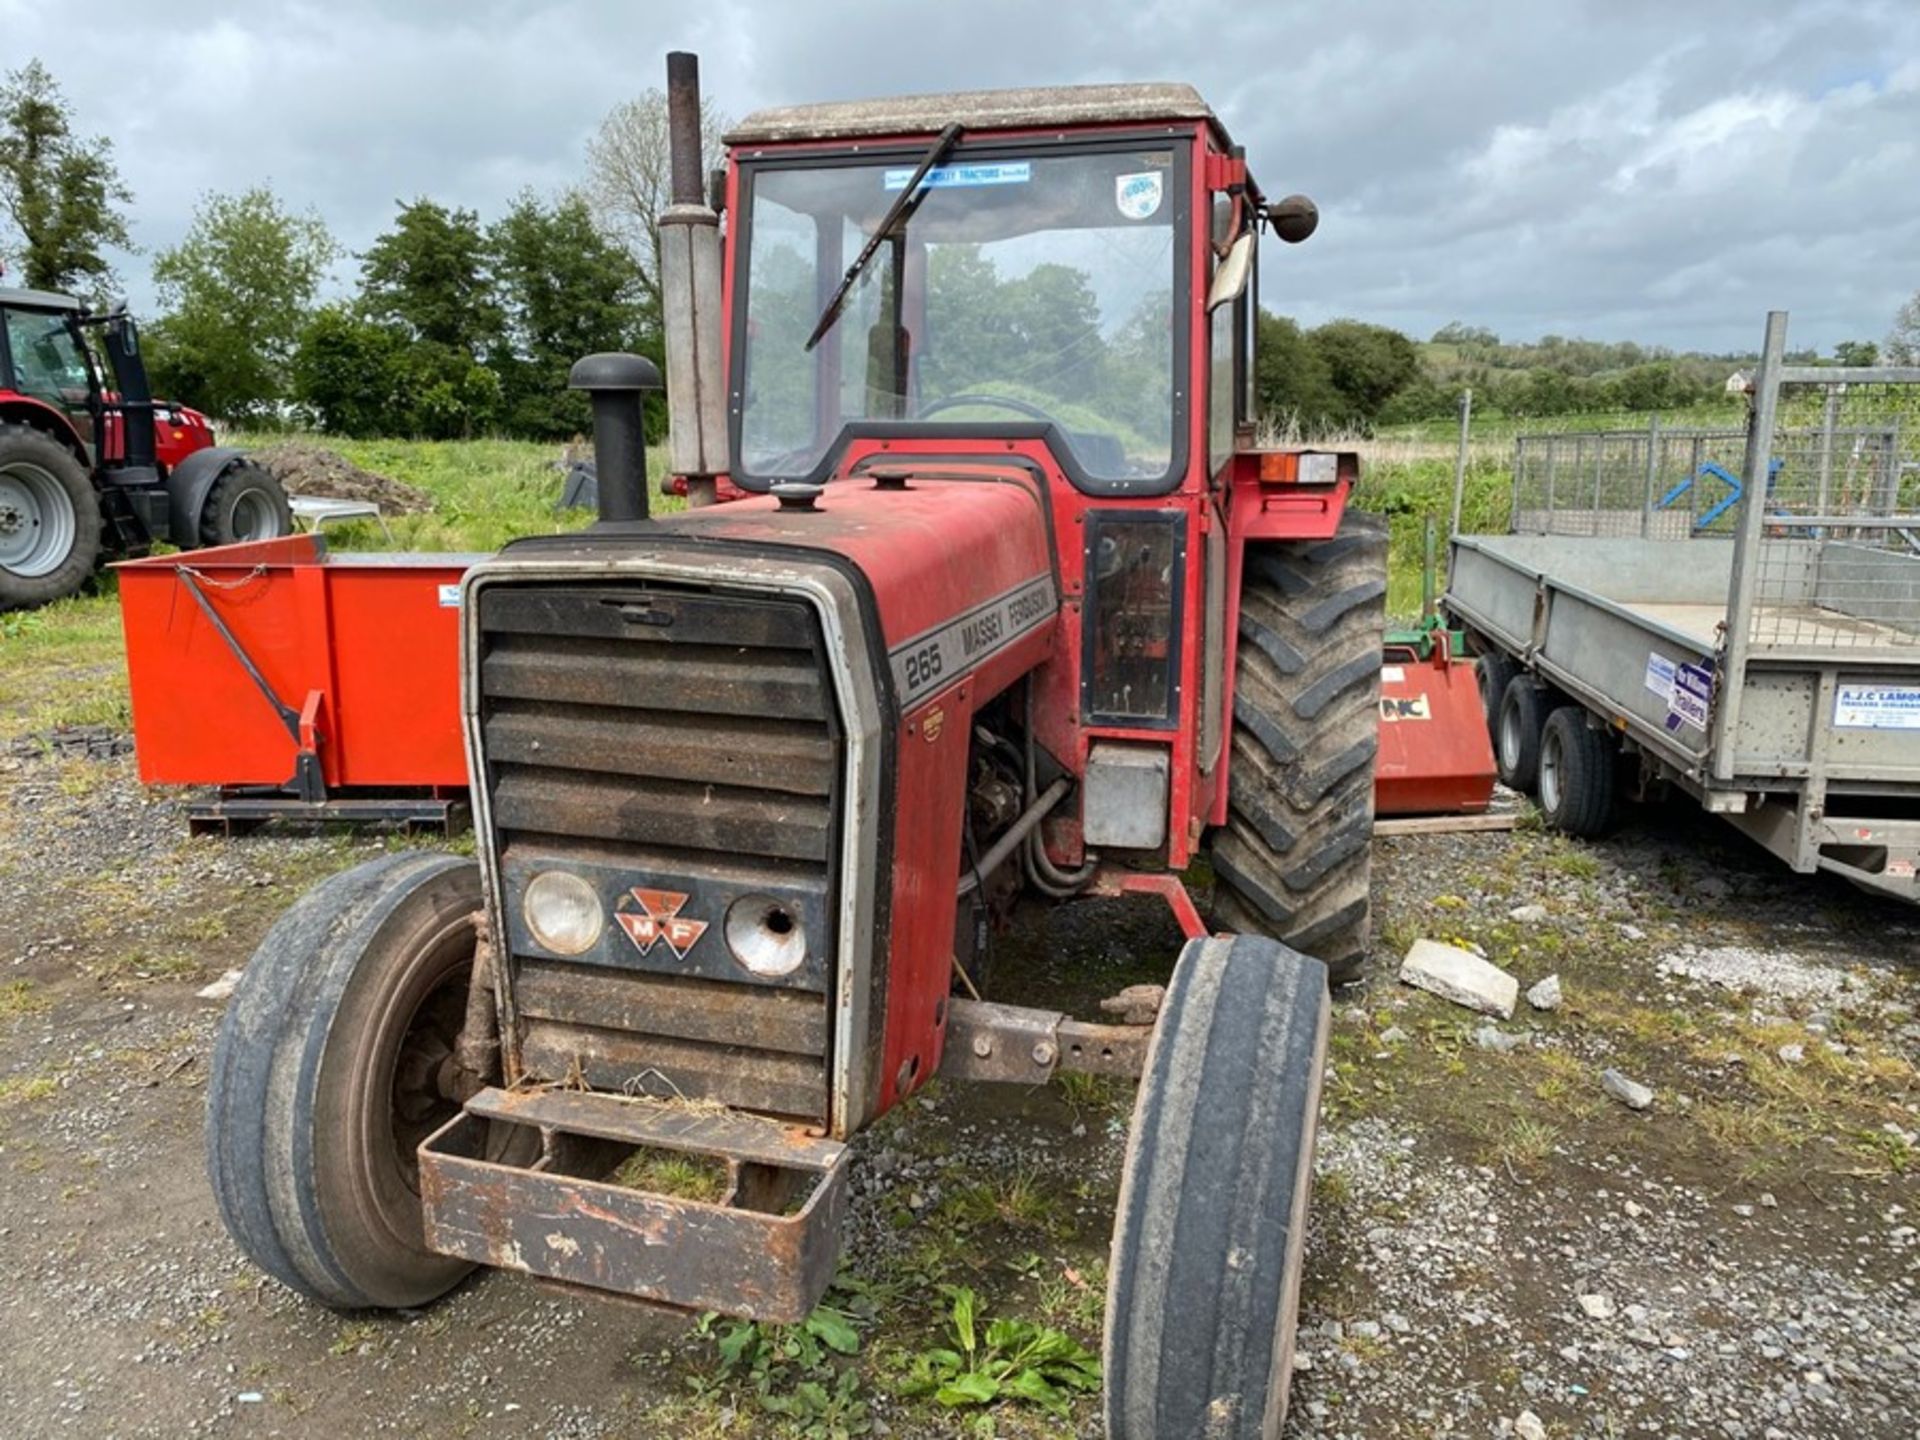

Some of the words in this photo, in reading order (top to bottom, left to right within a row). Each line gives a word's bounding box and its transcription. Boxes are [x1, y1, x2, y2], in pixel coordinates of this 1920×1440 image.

[959, 167, 1000, 179] TRACTORS
[905, 643, 942, 690] 265
[961, 608, 1003, 656] MASSEY
[1008, 585, 1050, 629] FERGUSON
